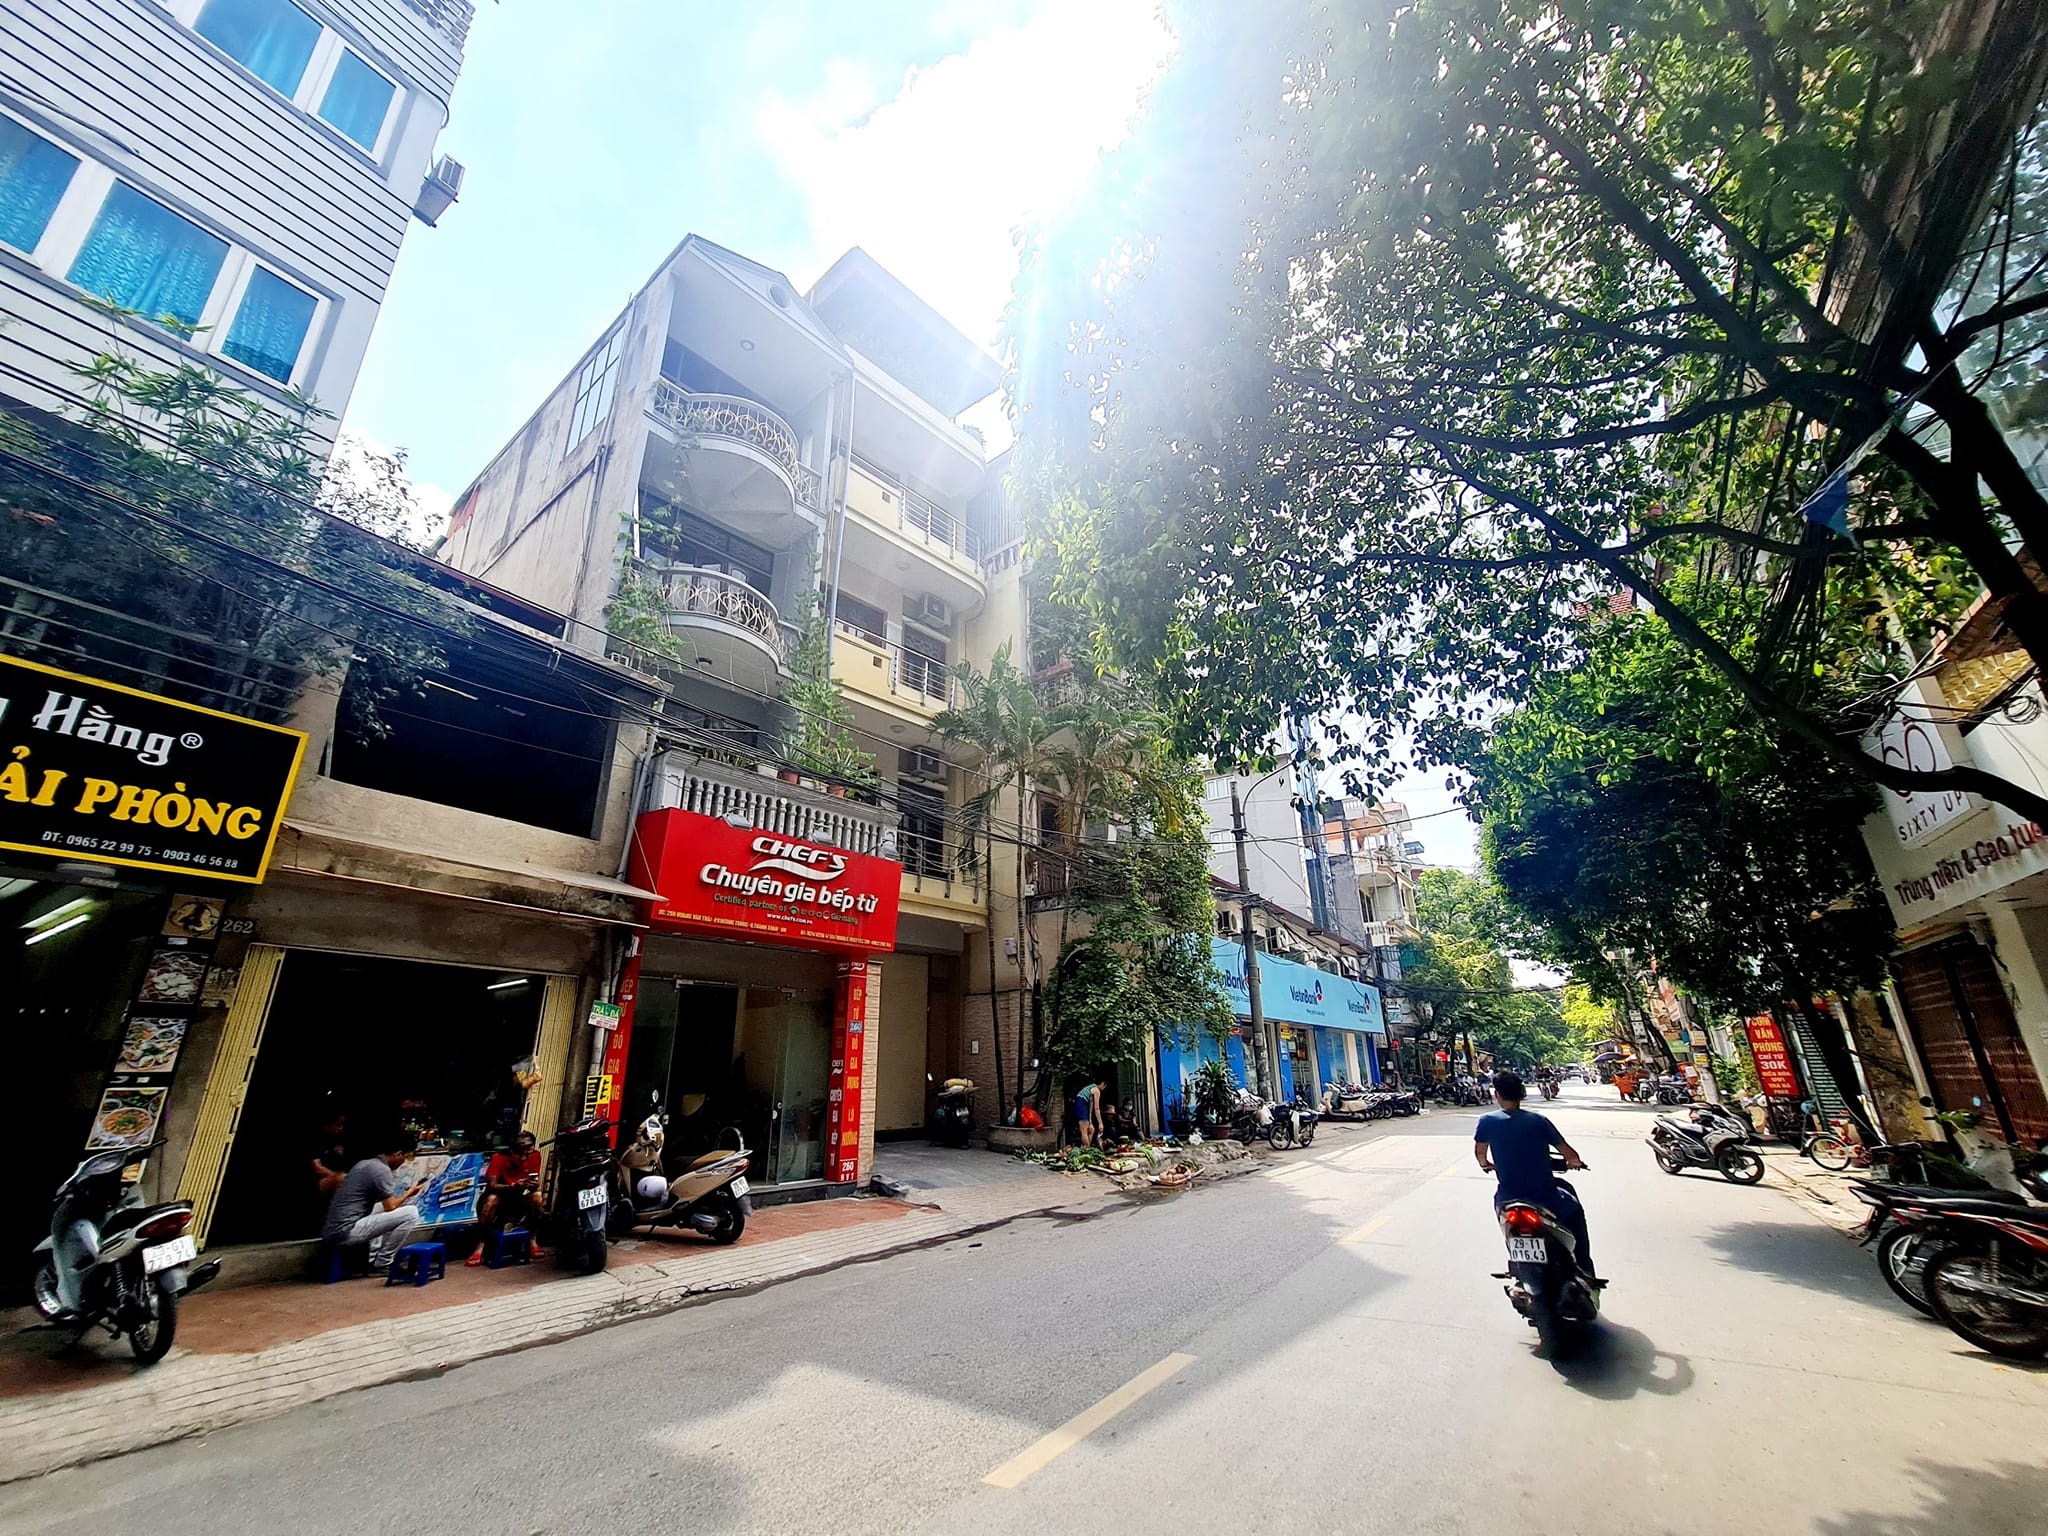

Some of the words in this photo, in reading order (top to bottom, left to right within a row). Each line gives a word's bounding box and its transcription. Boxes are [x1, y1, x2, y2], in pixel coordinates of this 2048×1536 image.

[74, 777, 262, 840] PHÒNG
[1898, 803, 1938, 842] SIXTY
[1942, 790, 1963, 812] UP
[42, 830, 62, 844] ĐT:
[66, 834, 98, 849] 0965
[100, 839, 117, 852] 22
[119, 842, 135, 854] 99
[138, 845, 153, 856] 75
[162, 848, 192, 863] 0903
[193, 853, 208, 866] 46
[209, 855, 223, 867] 56
[224, 857, 238, 869] 88
[752, 836, 848, 870] CHEF'S
[699, 863, 783, 896] Chuyên
[784, 881, 817, 903] gia
[818, 886, 854, 912] bếp
[856, 893, 879, 913] từ
[1894, 875, 1935, 906] Trung
[1931, 859, 1964, 889] niên
[222, 918, 254, 934] 262
[1752, 1040, 1785, 1052] PHÒNG
[1755, 1027, 1774, 1039] VĂN
[1760, 1060, 1787, 1070] 30K
[1513, 1250, 1546, 1262] 016.43
